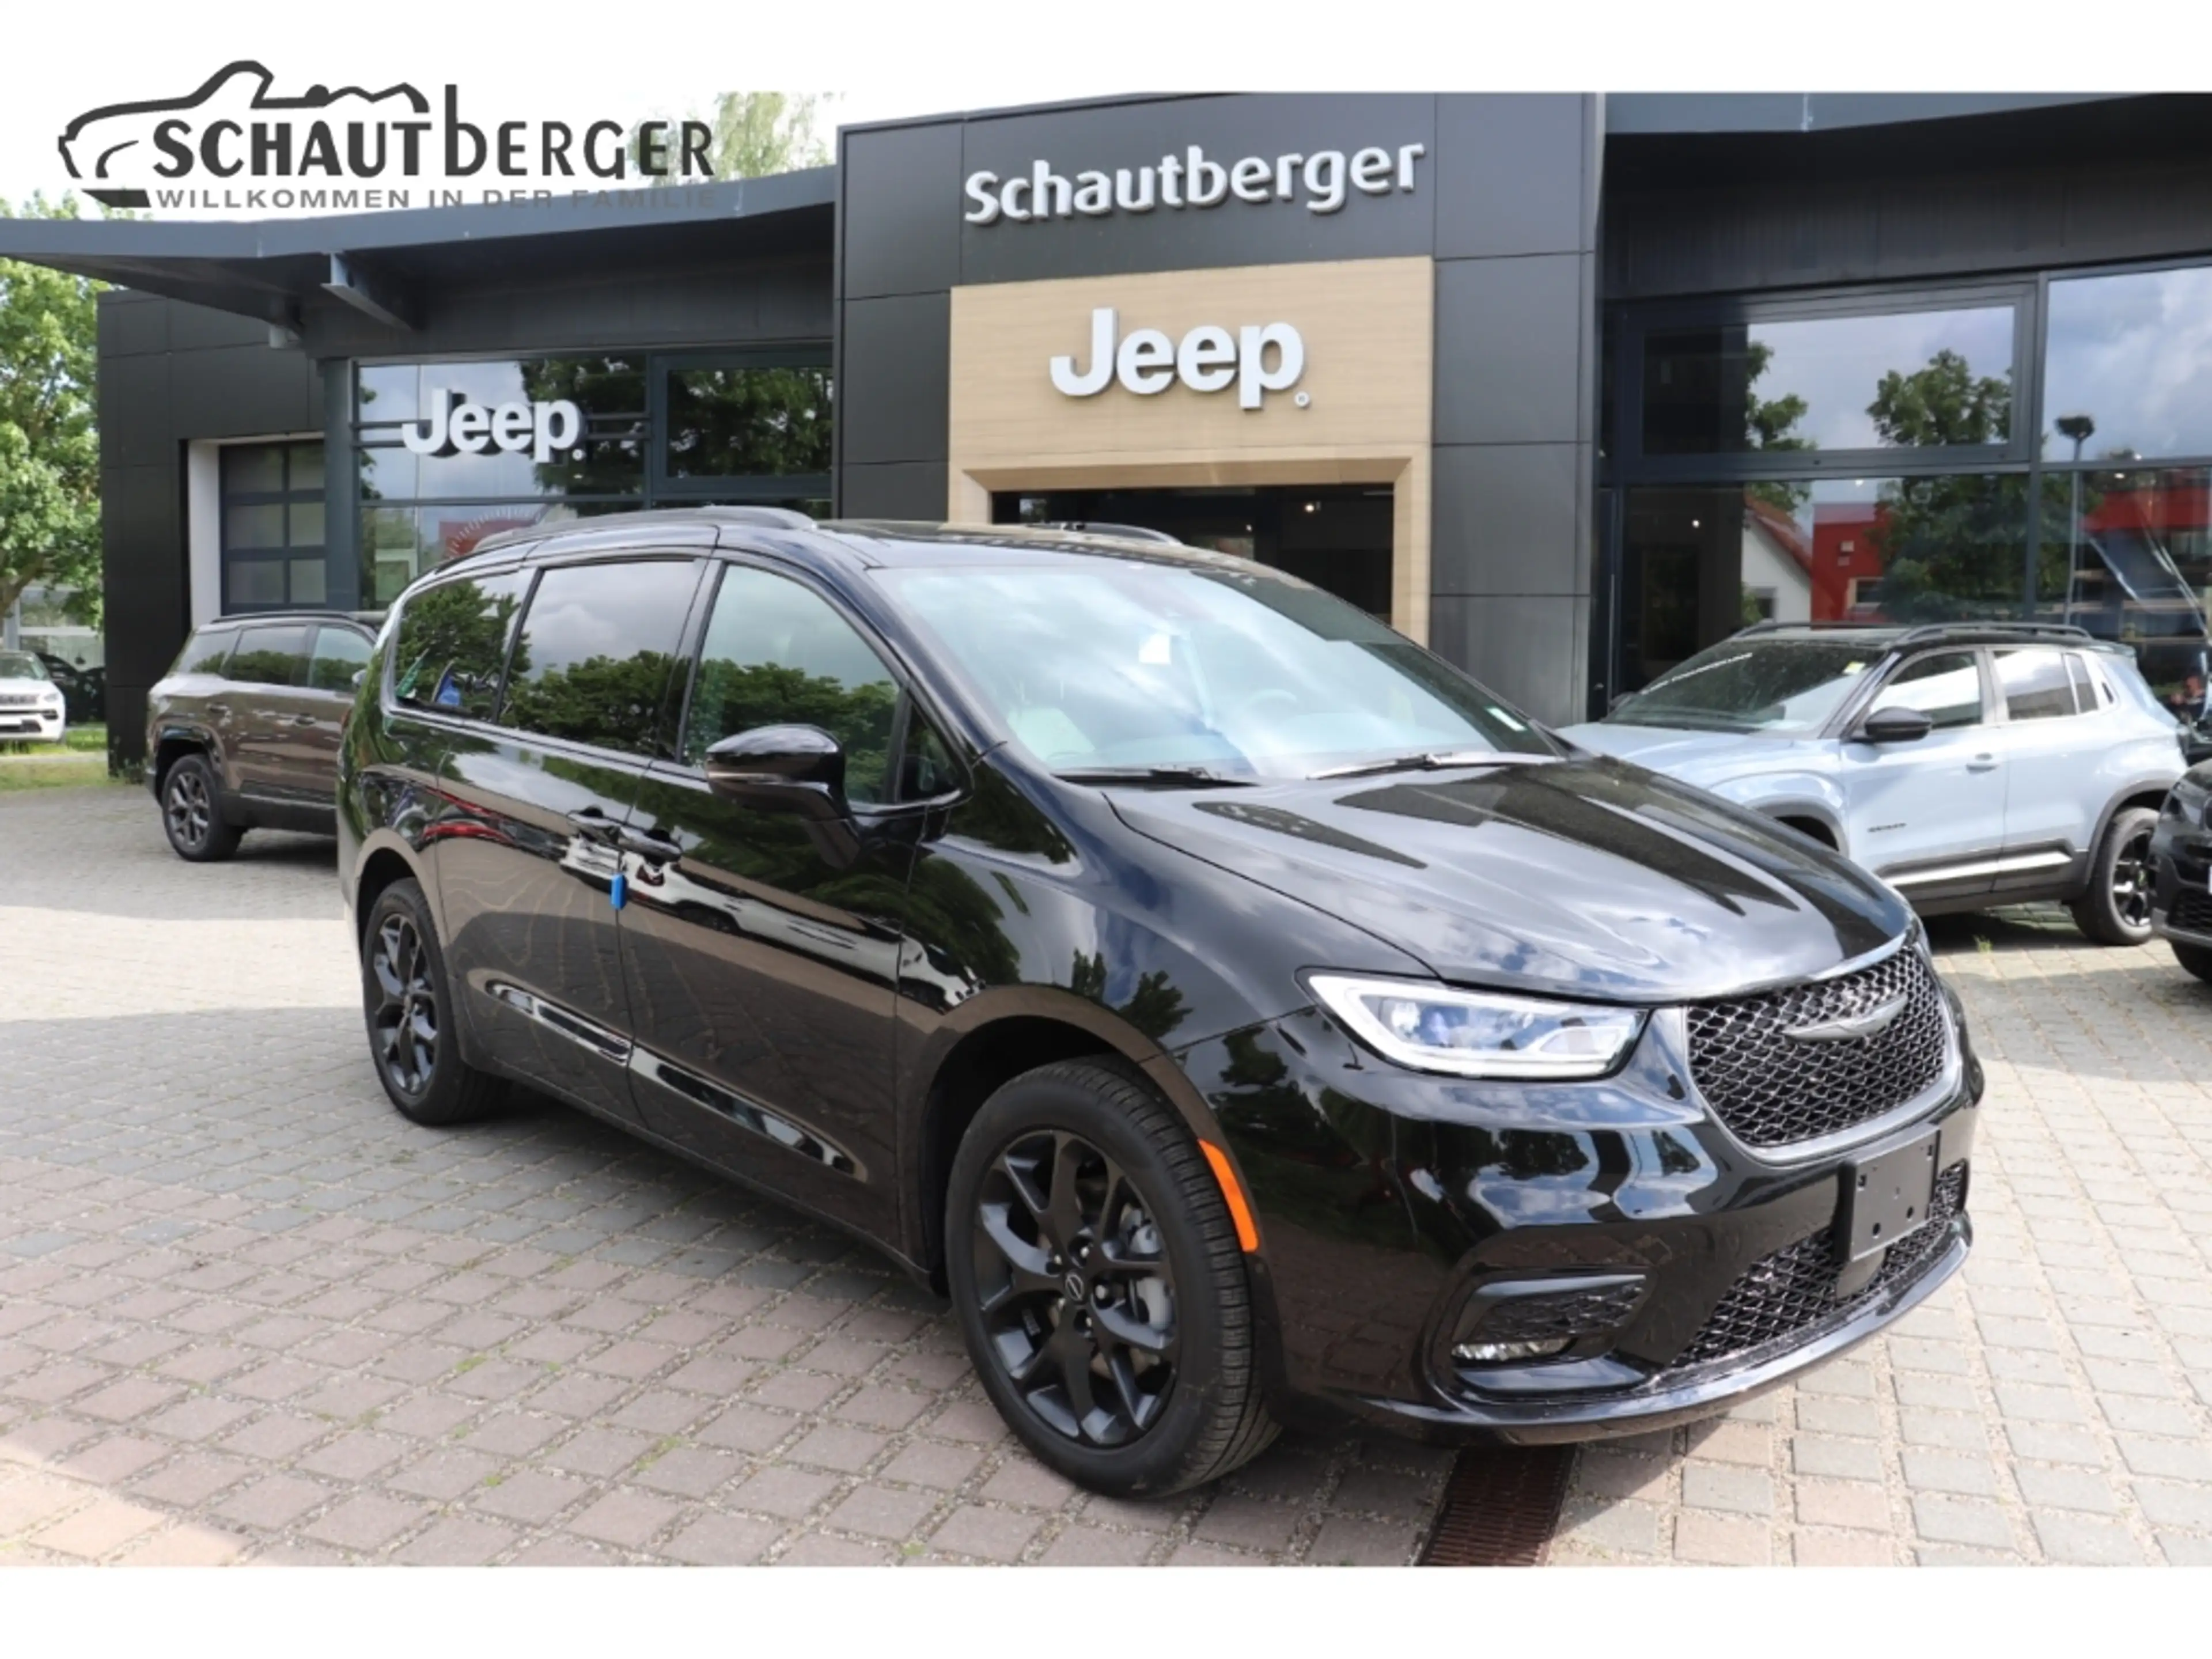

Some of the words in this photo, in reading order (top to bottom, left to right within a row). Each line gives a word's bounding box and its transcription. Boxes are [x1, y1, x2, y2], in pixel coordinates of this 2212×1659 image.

[965, 142, 1425, 225] Schautberger
[1050, 307, 1305, 410] Jeep
[402, 388, 583, 463] Jeep
